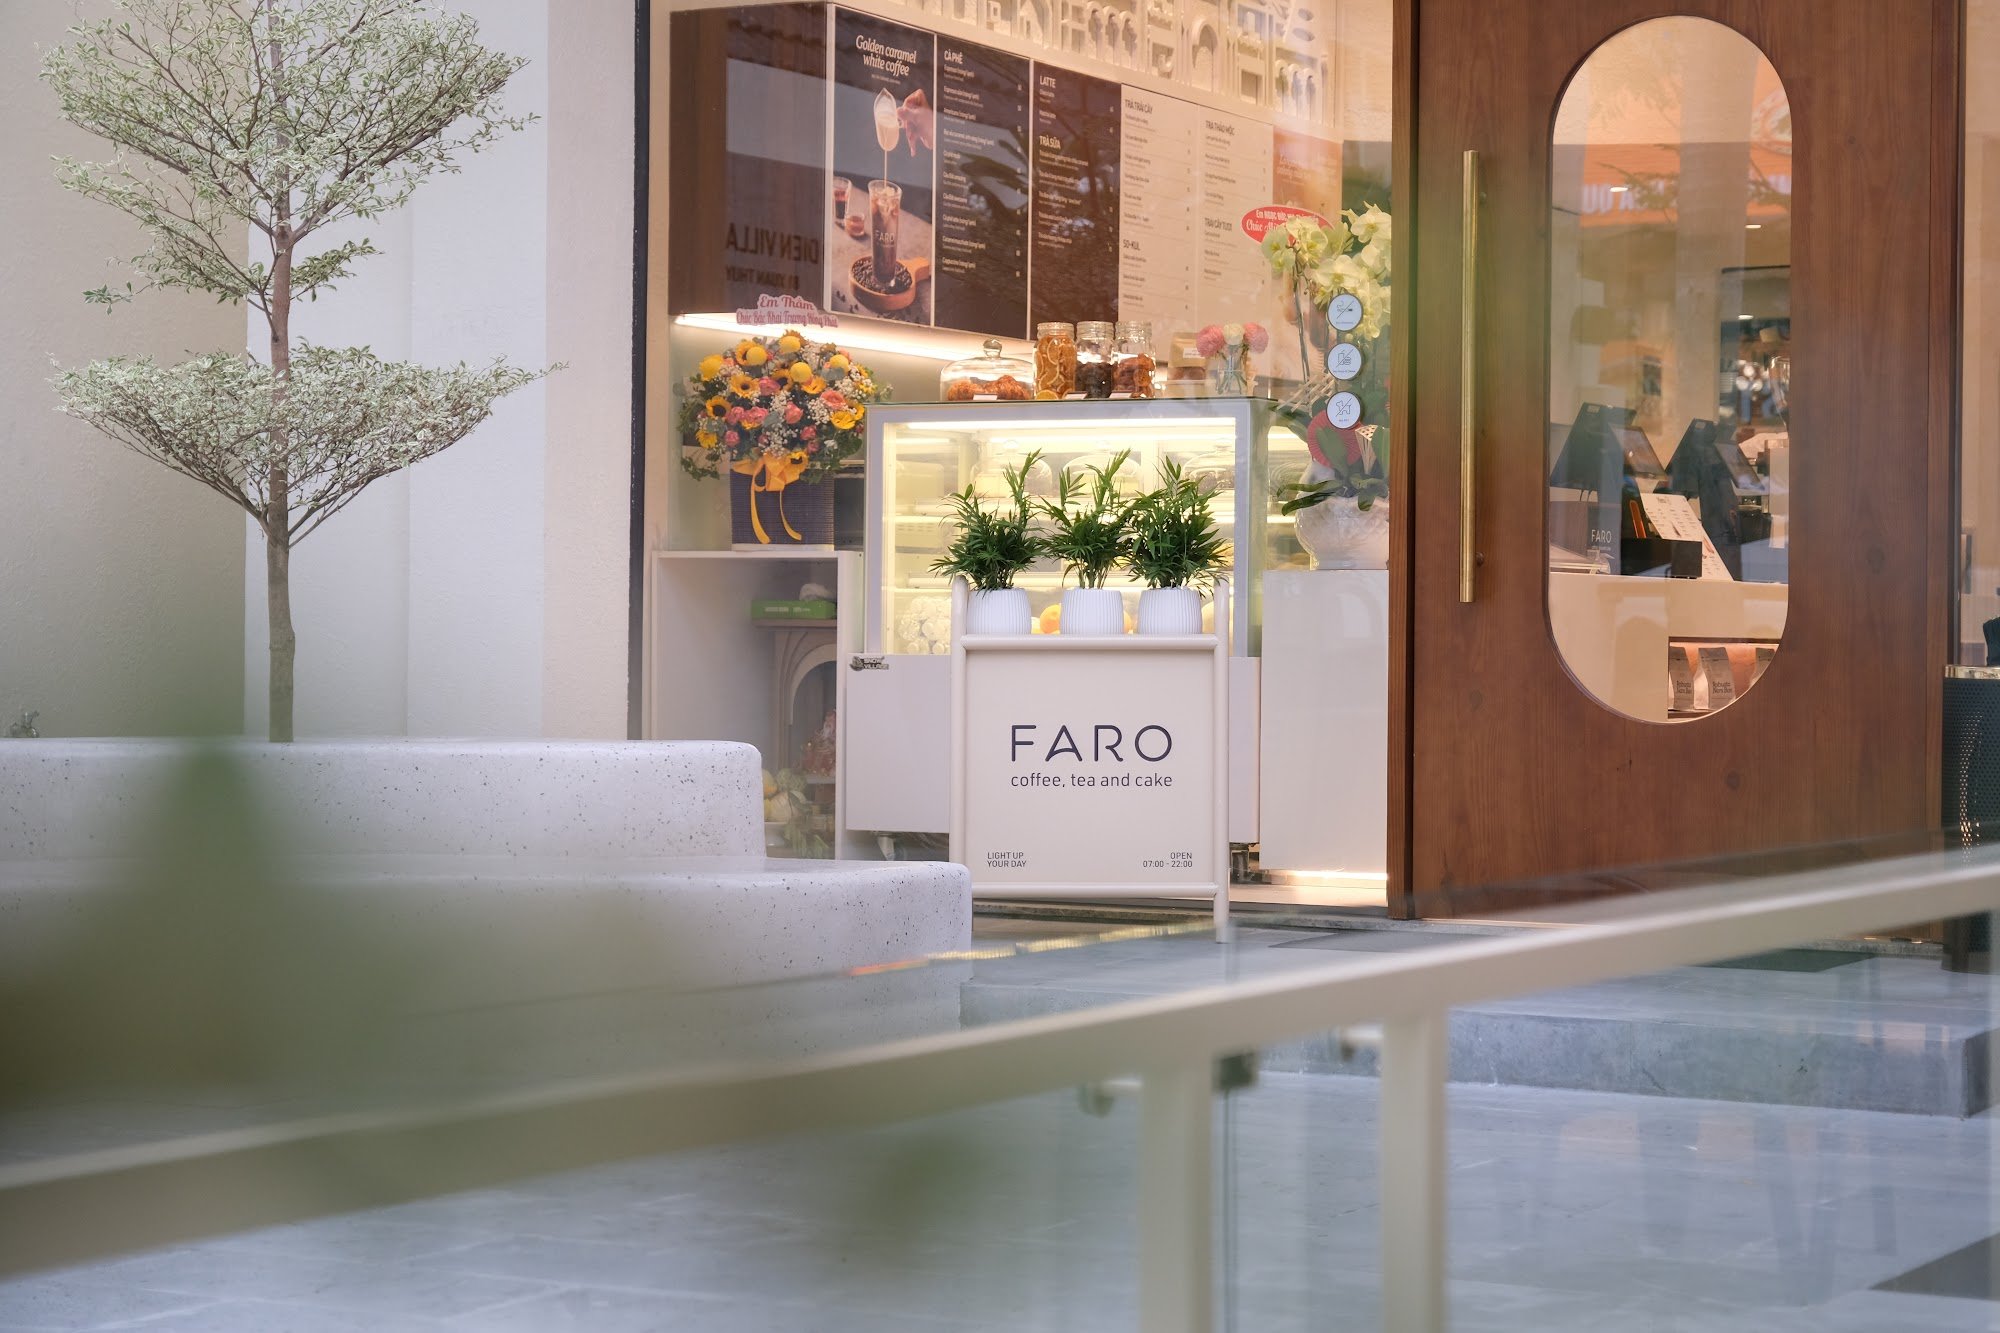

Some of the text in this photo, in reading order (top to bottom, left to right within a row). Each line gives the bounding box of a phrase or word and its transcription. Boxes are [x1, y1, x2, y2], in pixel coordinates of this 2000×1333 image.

[856, 34, 917, 64] Golden caramel
[863, 53, 910, 77] white coffee
[1039, 75, 1056, 89] LATTE
[760, 296, 778, 308] Em
[1591, 529, 1612, 544] FARO
[1011, 725, 1172, 762] FARO
[1011, 773, 1172, 788] coffee, tea and cake
[987, 851, 1024, 860] LIGHT UP
[1170, 851, 1193, 860] OPEN
[987, 860, 1027, 868] YOUR DAY
[1142, 860, 1164, 868] 07:00
[1171, 860, 1193, 868] 22:00
